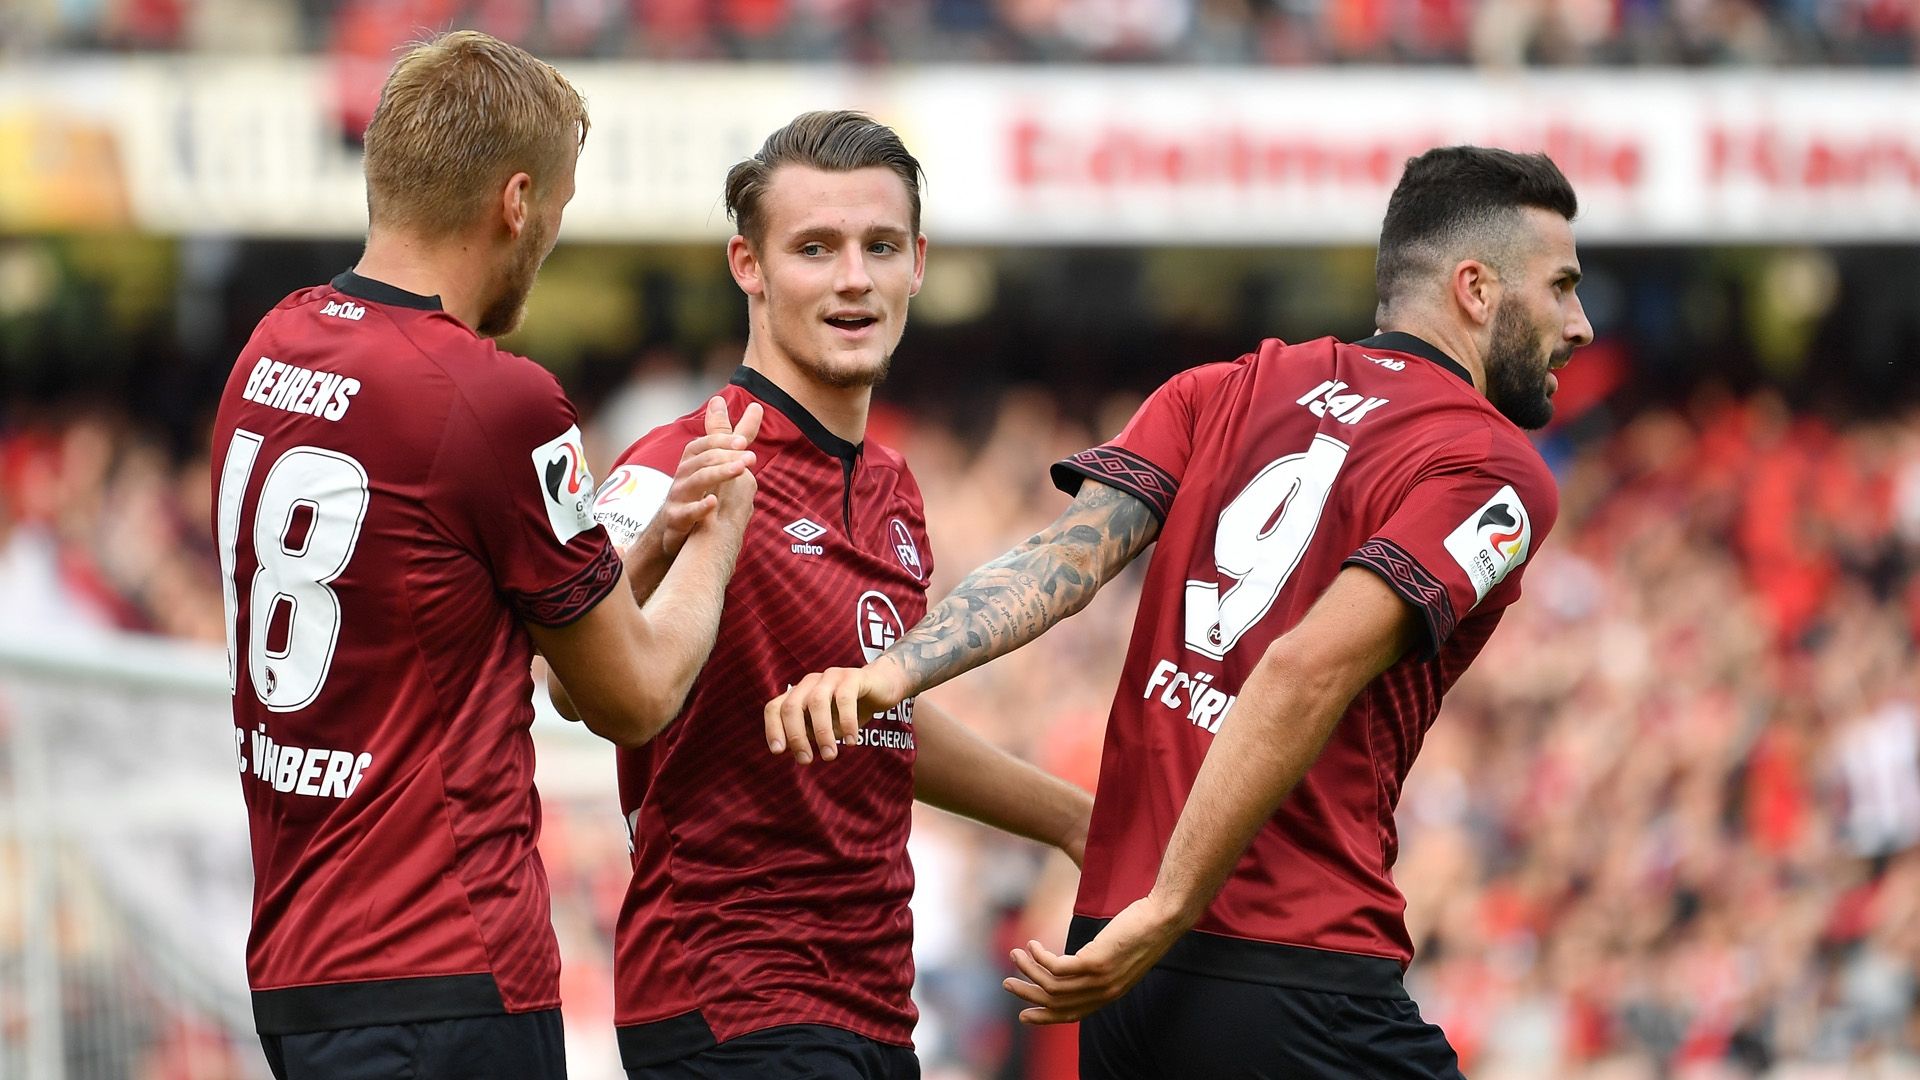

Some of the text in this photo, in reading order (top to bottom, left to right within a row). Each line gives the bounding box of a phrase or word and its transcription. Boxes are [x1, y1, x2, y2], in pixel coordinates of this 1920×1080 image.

[242, 356, 361, 422] BEHRENS
[218, 428, 370, 713] 18
[791, 542, 823, 556] umbro
[1185, 433, 1350, 661] 9
[1479, 549, 1497, 580] GERM
[1143, 659, 1190, 709] FC
